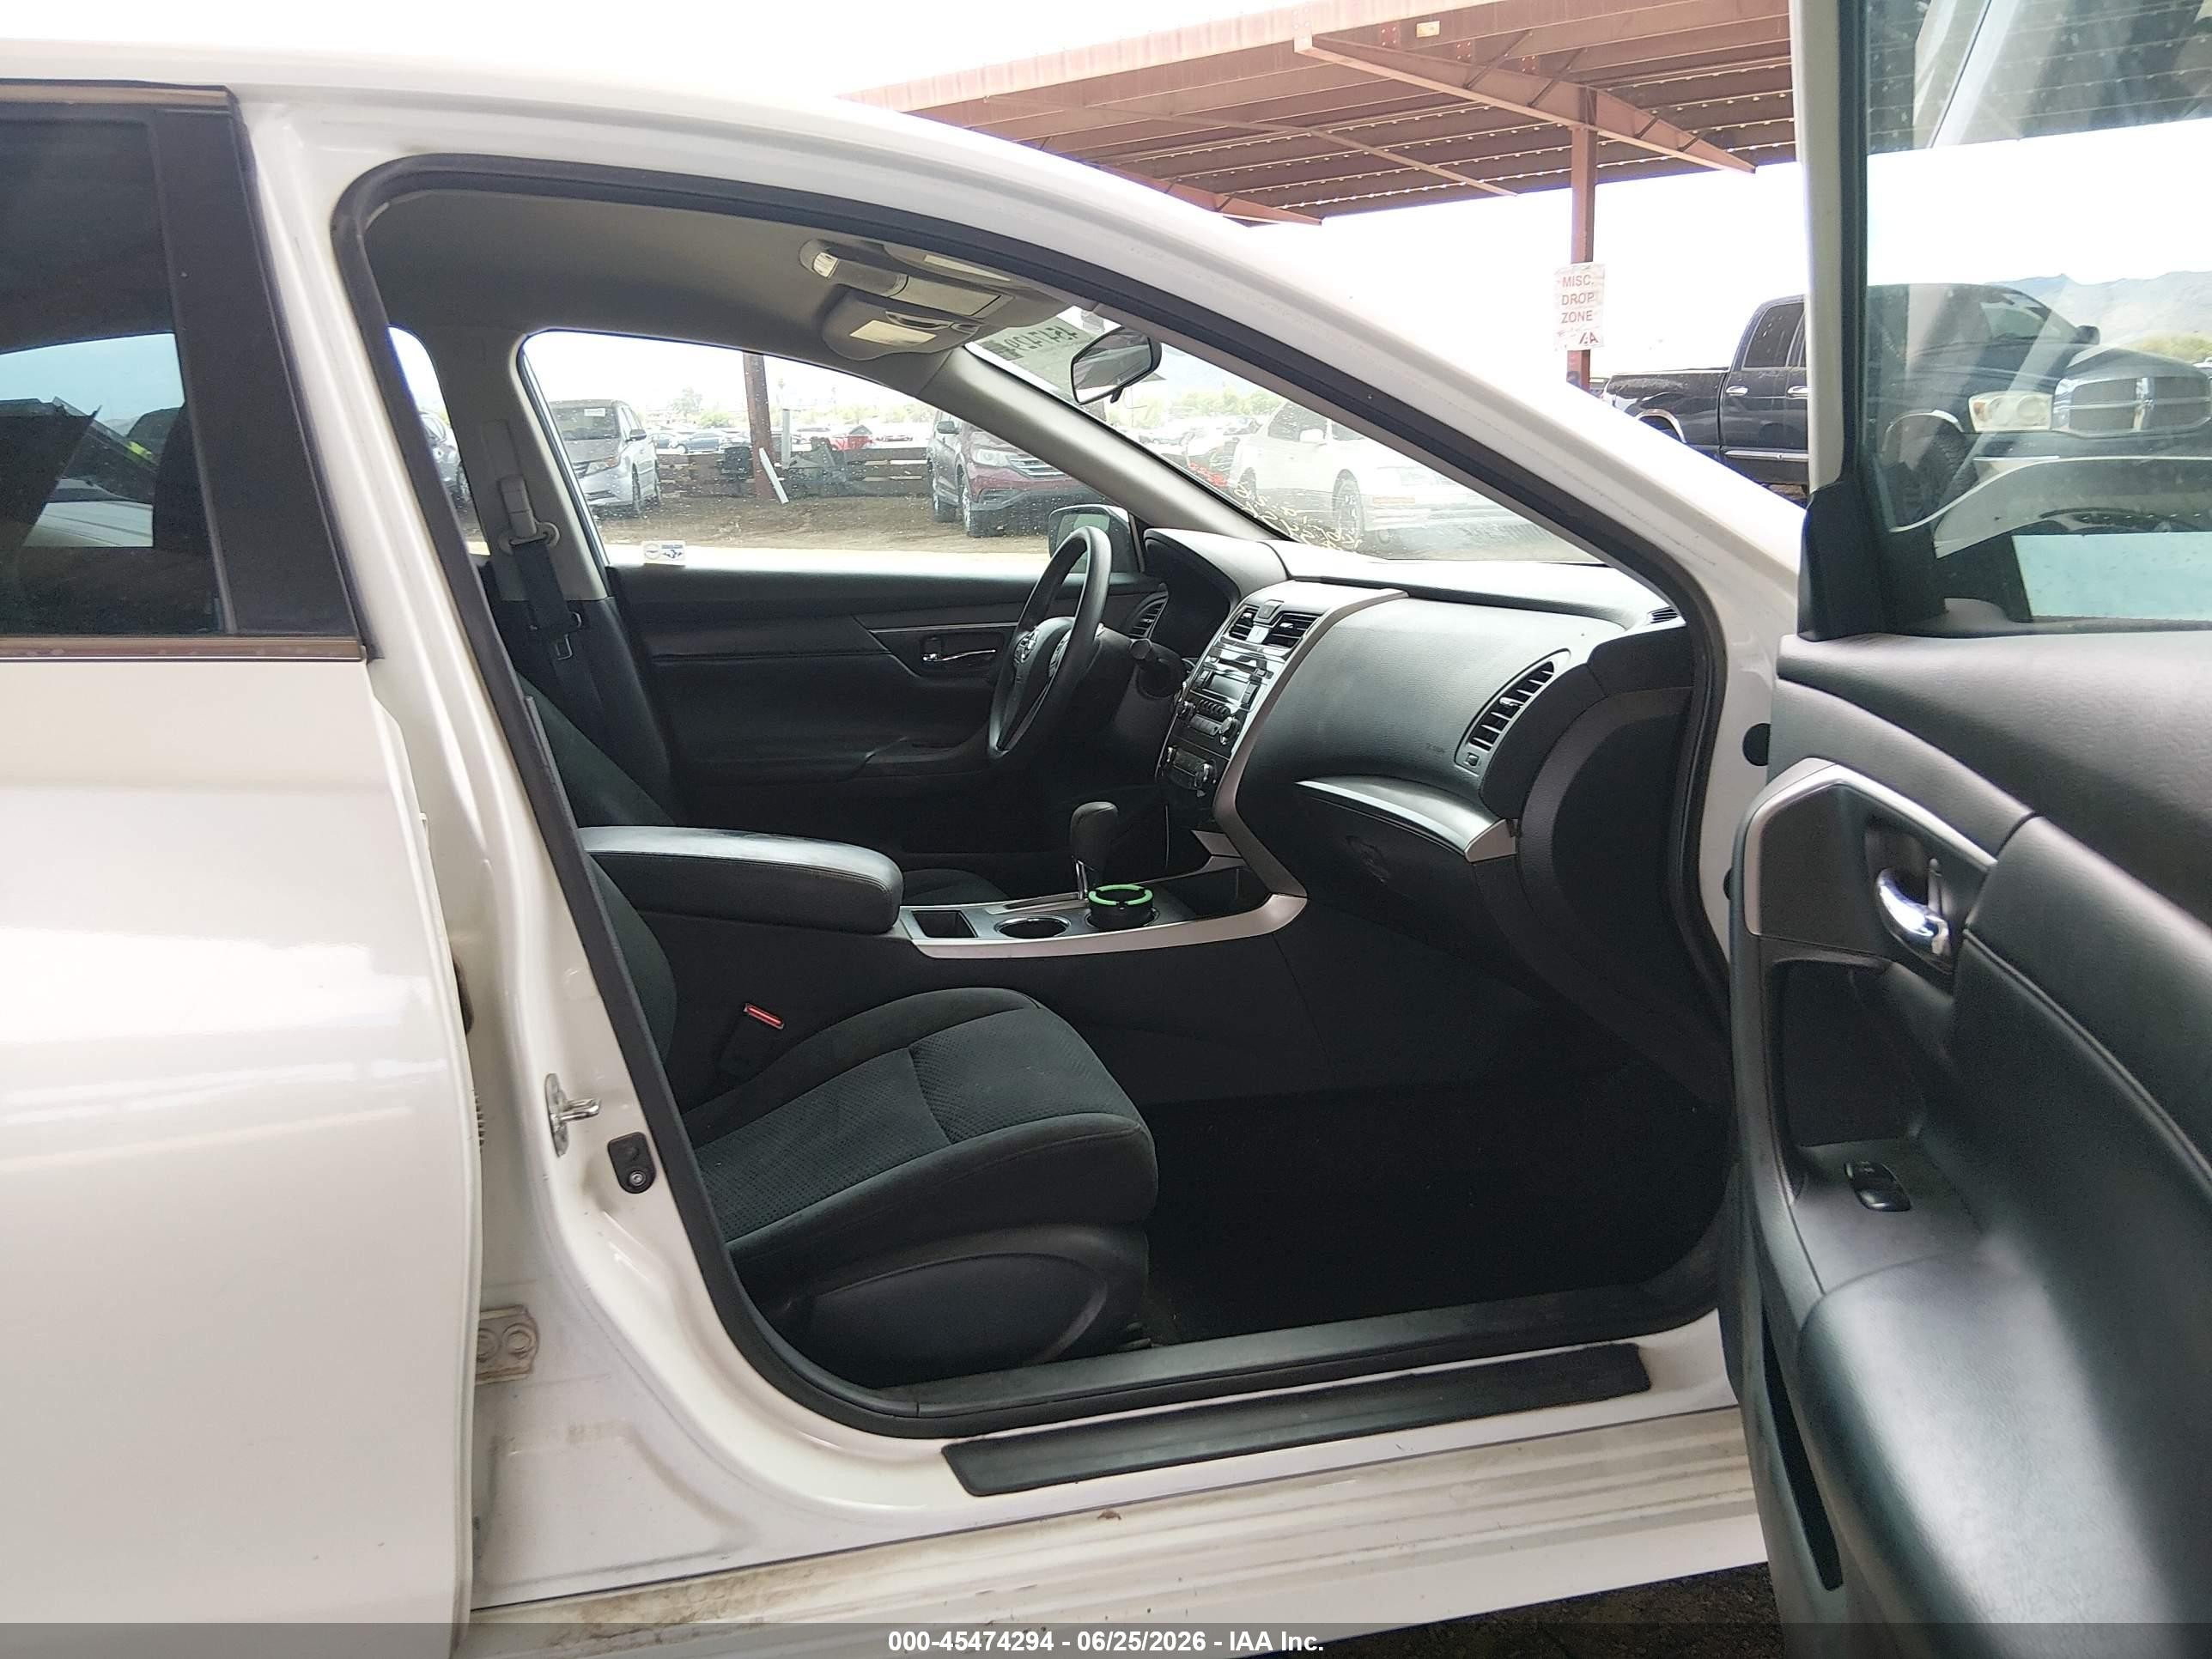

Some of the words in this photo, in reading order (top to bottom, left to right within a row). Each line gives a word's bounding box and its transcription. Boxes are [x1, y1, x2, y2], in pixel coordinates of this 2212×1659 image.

[1562, 274, 1595, 288] MISC.
[1561, 292, 1595, 306] DROP
[1560, 310, 1594, 324] ZONE
